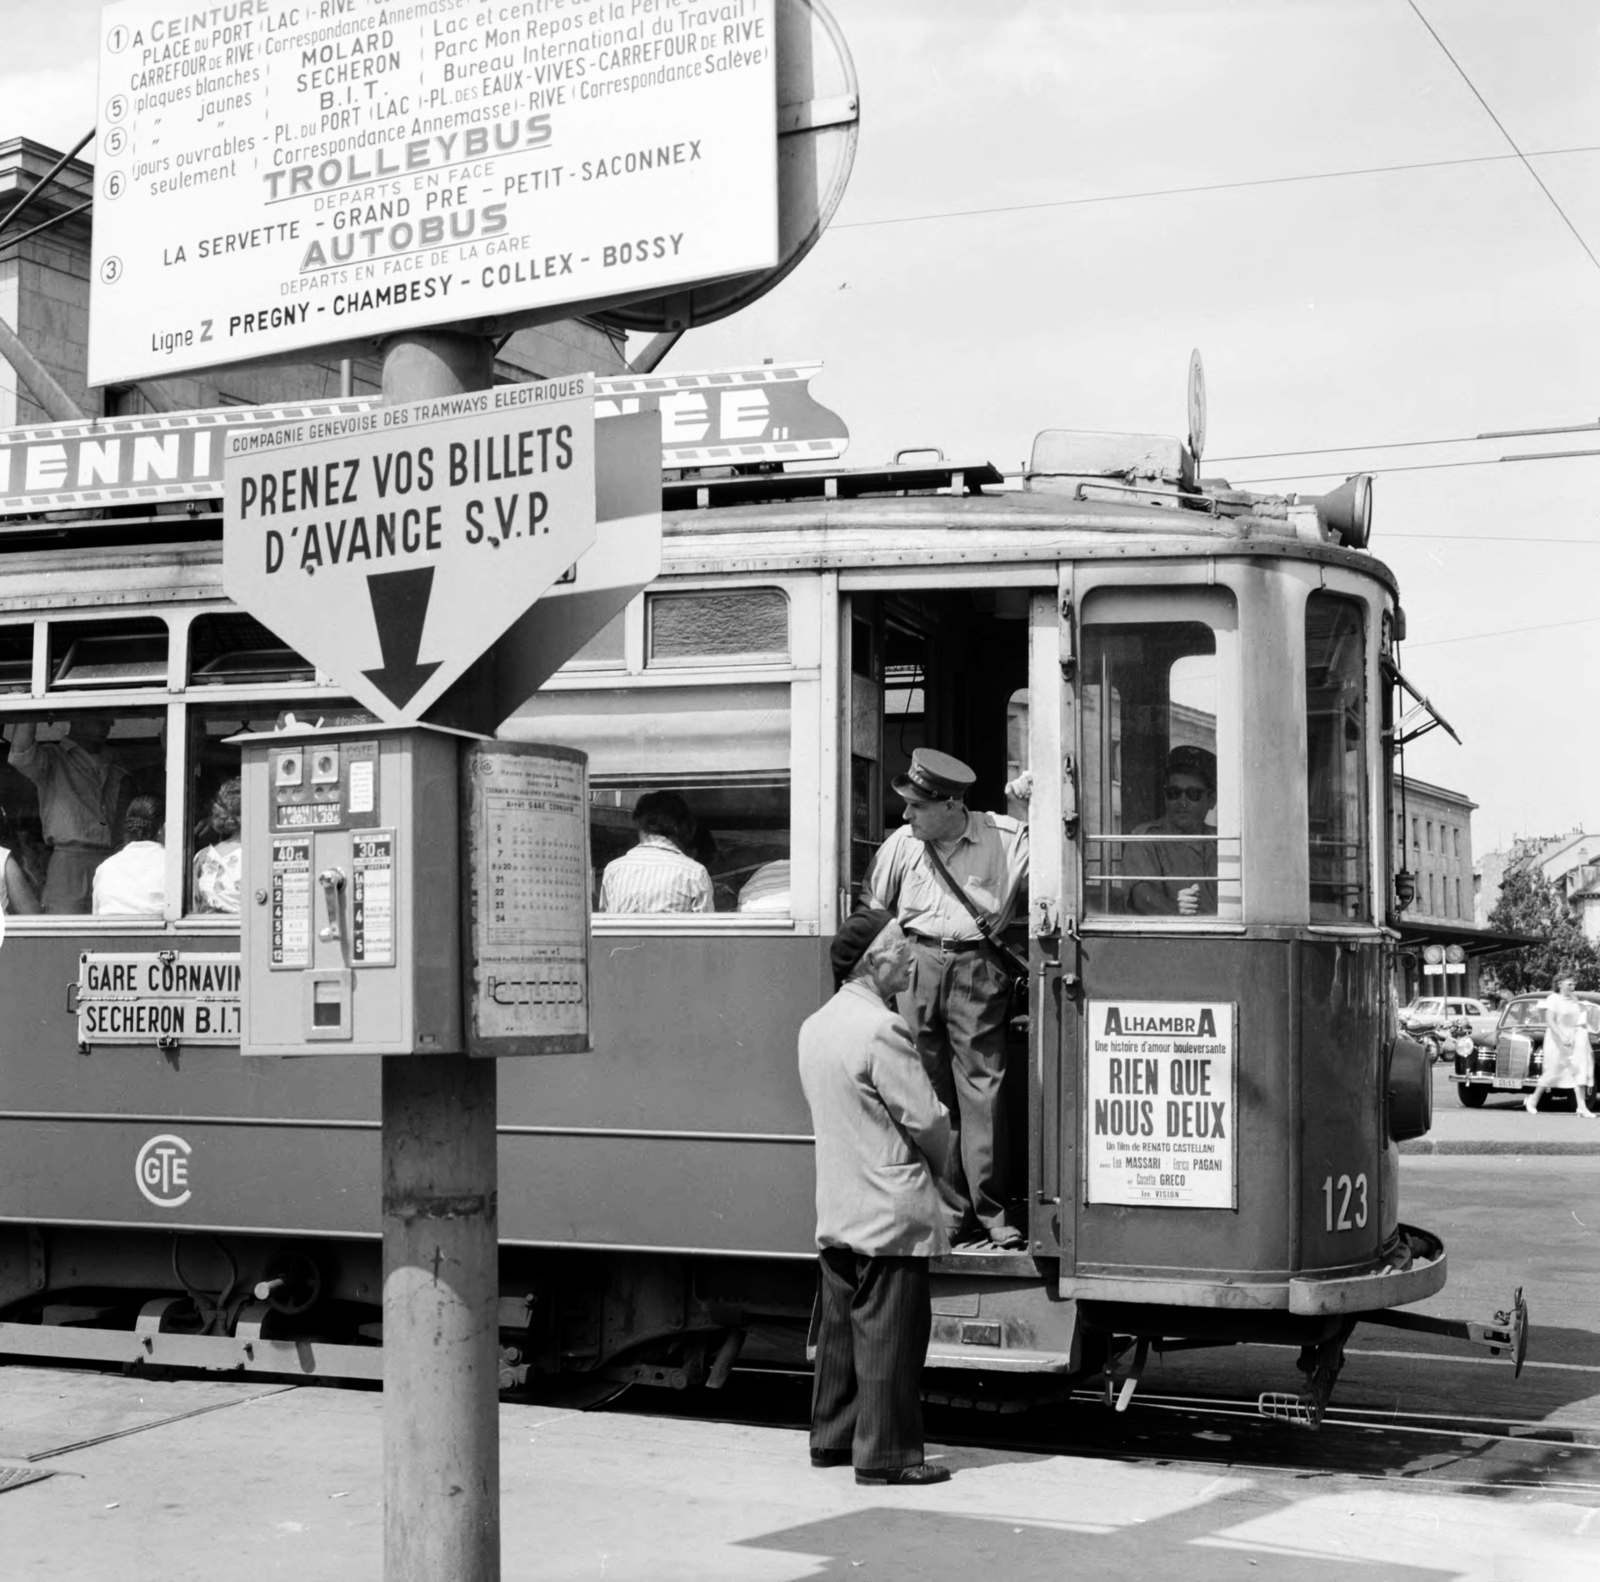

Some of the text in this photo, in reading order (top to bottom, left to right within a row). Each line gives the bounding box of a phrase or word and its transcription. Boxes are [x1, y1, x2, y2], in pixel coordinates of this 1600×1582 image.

[133, 30, 144, 48] A
[151, 0, 269, 42] CEINTURE
[143, 38, 190, 67] PLACE
[195, 38, 208, 52] DU
[213, 21, 254, 48] PORT
[302, 30, 393, 69] MOLARD
[476, 7, 492, 27] et
[523, 20, 643, 64] International
[652, 16, 673, 36] du
[131, 55, 206, 91] CARREFOUR
[209, 56, 222, 70] DE
[226, 42, 254, 66] RIVE
[197, 92, 251, 122] jaunes
[296, 51, 400, 93] SECHERON
[485, 28, 520, 49] Mon
[527, 14, 583, 39] Repos
[589, 5, 604, 25] et
[609, 3, 624, 21] la
[176, 136, 255, 167] ouvrables
[301, 123, 316, 138] DU
[321, 106, 361, 133] PORT
[456, 86, 478, 103] DES
[701, 33, 717, 50] DE
[724, 18, 765, 45] RIVE
[529, 85, 566, 112] RIVE
[263, 113, 553, 200] TROLLEYBUS
[313, 161, 495, 212] DEPARTS EN FACE
[163, 245, 187, 267] LA
[199, 220, 301, 258] SERVETTE
[333, 199, 410, 231] GRAND
[426, 186, 468, 211] PRE
[300, 202, 508, 272] AUTOBUS
[280, 234, 531, 296] DEPARTS EN FACE DE LA GARE
[152, 232, 684, 354] Ligne Z PREGNY CHAMBESY COLLEX BOSSY
[232, 380, 585, 452] COMPAGNIE GENEVOISE DES TRAMWAYS ELECTRIQUES
[241, 424, 573, 520] PRENEZ VOS BILLETS
[266, 505, 442, 574] D'AVANCE
[275, 890, 282, 902] 2
[275, 906, 282, 917] 4
[355, 889, 362, 900] 6
[275, 921, 281, 931] 5
[355, 909, 362, 923] 4
[275, 934, 281, 945] 6
[355, 939, 363, 953] 5
[88, 964, 138, 991] GARE
[86, 1005, 184, 1033] SECHERON
[1095, 1041, 1226, 1054] Une histoire d'amour bouleversante
[1109, 1058, 1211, 1096] RIEN QUE
[1095, 1099, 1226, 1138] NOUS DEUX
[1106, 1141, 1215, 1154] Un film de RENATO CASTELLANI
[1126, 1157, 1161, 1169] MASSARI
[1193, 1159, 1223, 1171] PAGANI
[1155, 1190, 1180, 1198] VISION
[1160, 1174, 1185, 1186] GRECO
[1322, 1173, 1368, 1232] 123
